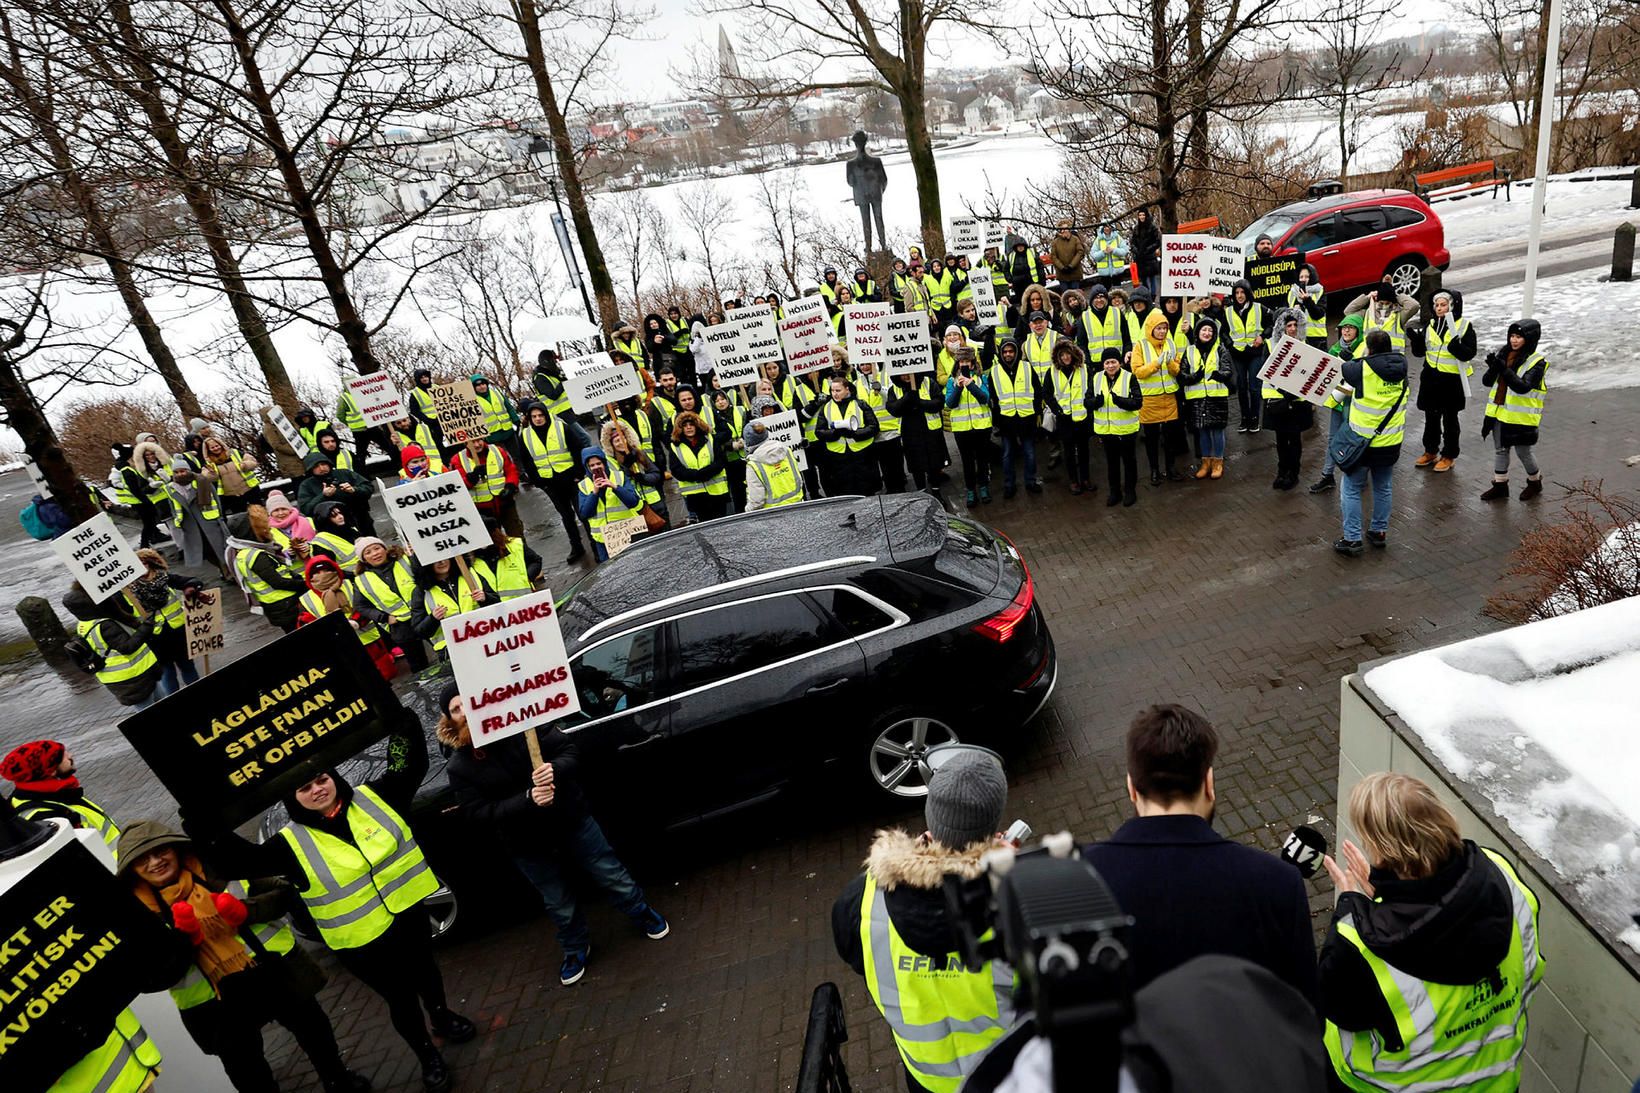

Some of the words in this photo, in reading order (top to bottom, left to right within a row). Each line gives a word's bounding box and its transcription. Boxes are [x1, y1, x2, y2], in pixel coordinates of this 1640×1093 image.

[1166, 242, 1206, 250] SOLIDAR-
[1212, 244, 1242, 254] HÓTELIN
[1172, 254, 1198, 264] NOŚĆ
[1220, 256, 1234, 264] ERU
[1215, 268, 1242, 277] OKKAR
[1209, 278, 1236, 288] HÖNDU
[730, 308, 771, 321] LÁGMARKS
[788, 301, 820, 316] HÓTELIN
[742, 320, 763, 330] LAUN
[782, 315, 823, 332] LÁGMARKS
[887, 320, 920, 330] HOTELE
[706, 329, 740, 343] HÓTELIN
[794, 328, 816, 338] LAUN
[908, 332, 918, 340] W
[720, 344, 736, 354] ERU
[788, 344, 830, 361] LÁGMARKS
[886, 344, 928, 356] NASZYCH
[576, 358, 595, 367] THE
[720, 354, 750, 366] OKKAR
[794, 356, 830, 372] FRAMLAG
[1264, 340, 1294, 380] MINIMUM
[1280, 354, 1301, 378] WAGE
[719, 366, 756, 380] HÖNDUM
[1300, 357, 1331, 396] MINIMUM
[350, 374, 388, 389] MINIMUM
[1315, 368, 1338, 396] EFFORT
[361, 384, 385, 396] WAGE
[430, 386, 454, 398] YOU
[363, 400, 400, 414] MINIMUM
[434, 394, 464, 407] PLEASE
[371, 410, 399, 422] EFFORT
[438, 405, 482, 422] IGNORE
[442, 417, 478, 432] UNHAPPY
[396, 483, 462, 508] SOLIDAR-
[414, 500, 456, 522] NOŚĆ
[417, 516, 470, 538] NASZA
[72, 527, 95, 544] THE
[434, 534, 470, 552] SIŁA
[72, 533, 112, 561] HOTELS
[84, 554, 105, 572] ARE
[107, 544, 120, 558] IN
[97, 559, 122, 578] OUR
[98, 566, 135, 594] HANDS
[187, 612, 214, 626] have
[452, 602, 552, 643] LÁGMARKS
[193, 624, 212, 636] the
[190, 634, 224, 655] POWER
[483, 630, 536, 658] LAUN
[470, 666, 568, 711] LÁGMARKS
[482, 692, 570, 734] FRAMLAG
[228, 761, 264, 787] ER
[33, 896, 76, 930] ER
